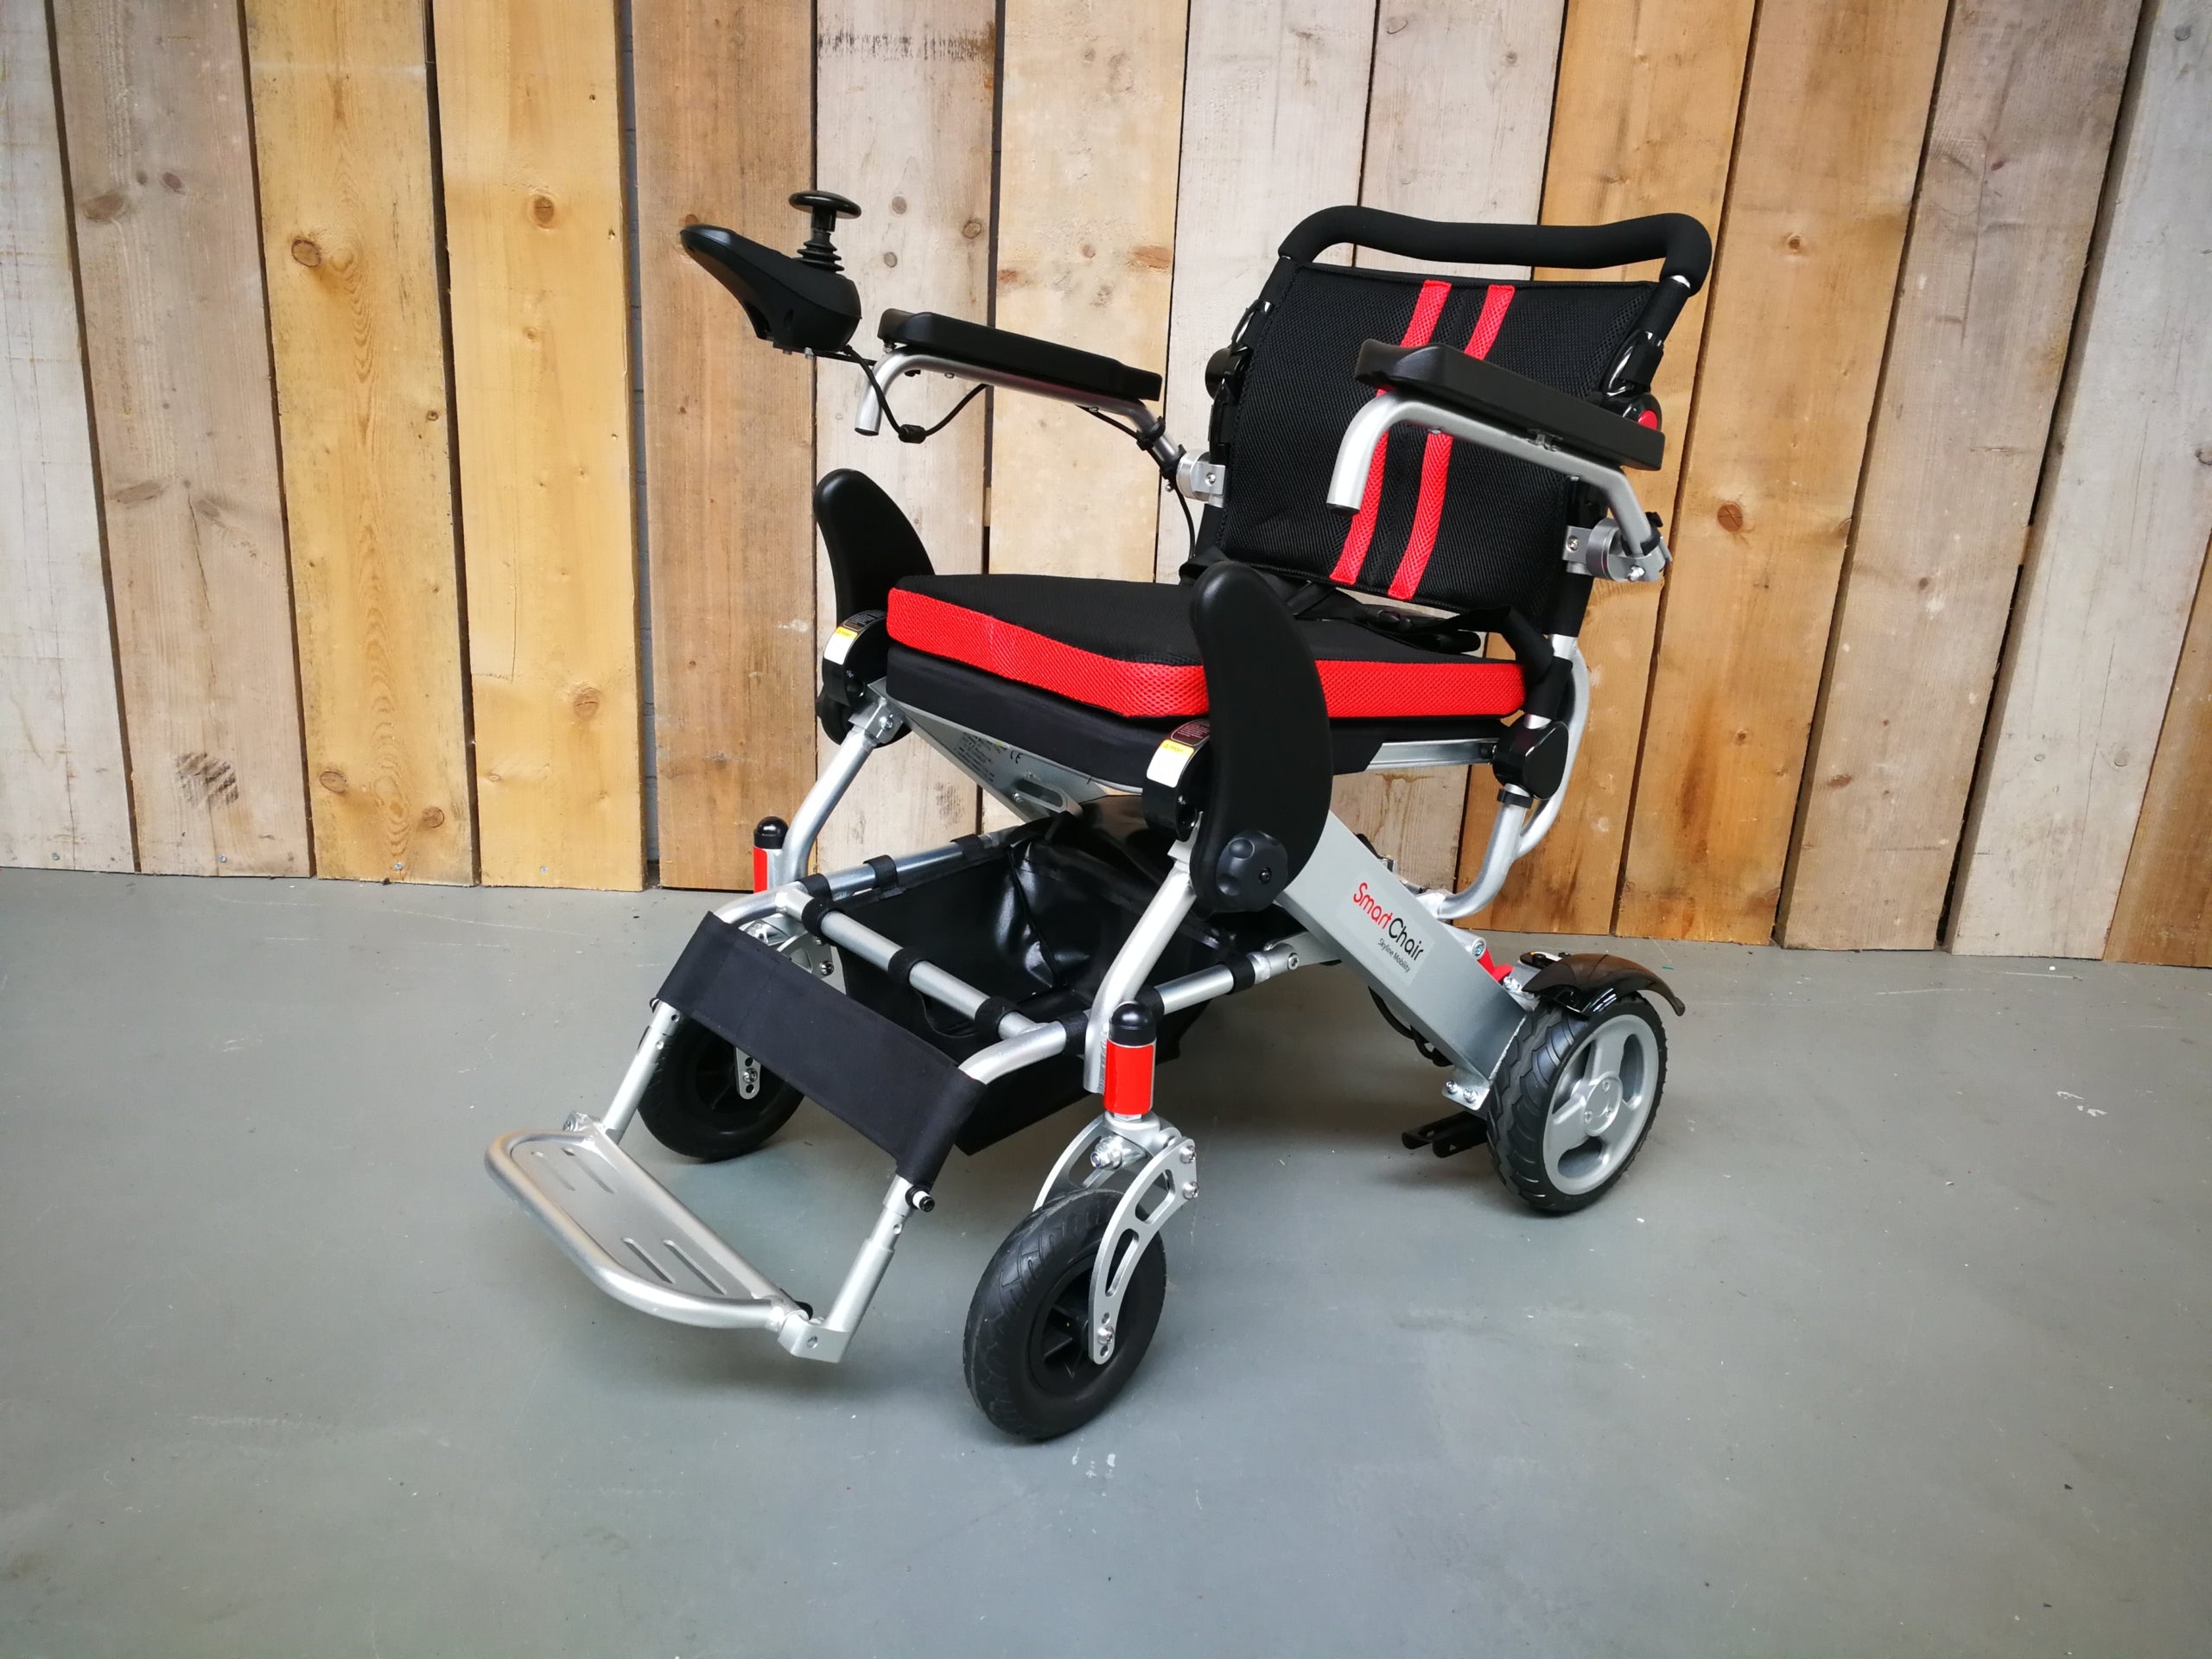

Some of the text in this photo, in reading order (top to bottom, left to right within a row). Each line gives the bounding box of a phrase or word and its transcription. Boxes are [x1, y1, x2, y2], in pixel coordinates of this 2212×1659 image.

[1353, 882, 1424, 961] SmartChair
[1377, 938, 1410, 973] Skyline Mobility
